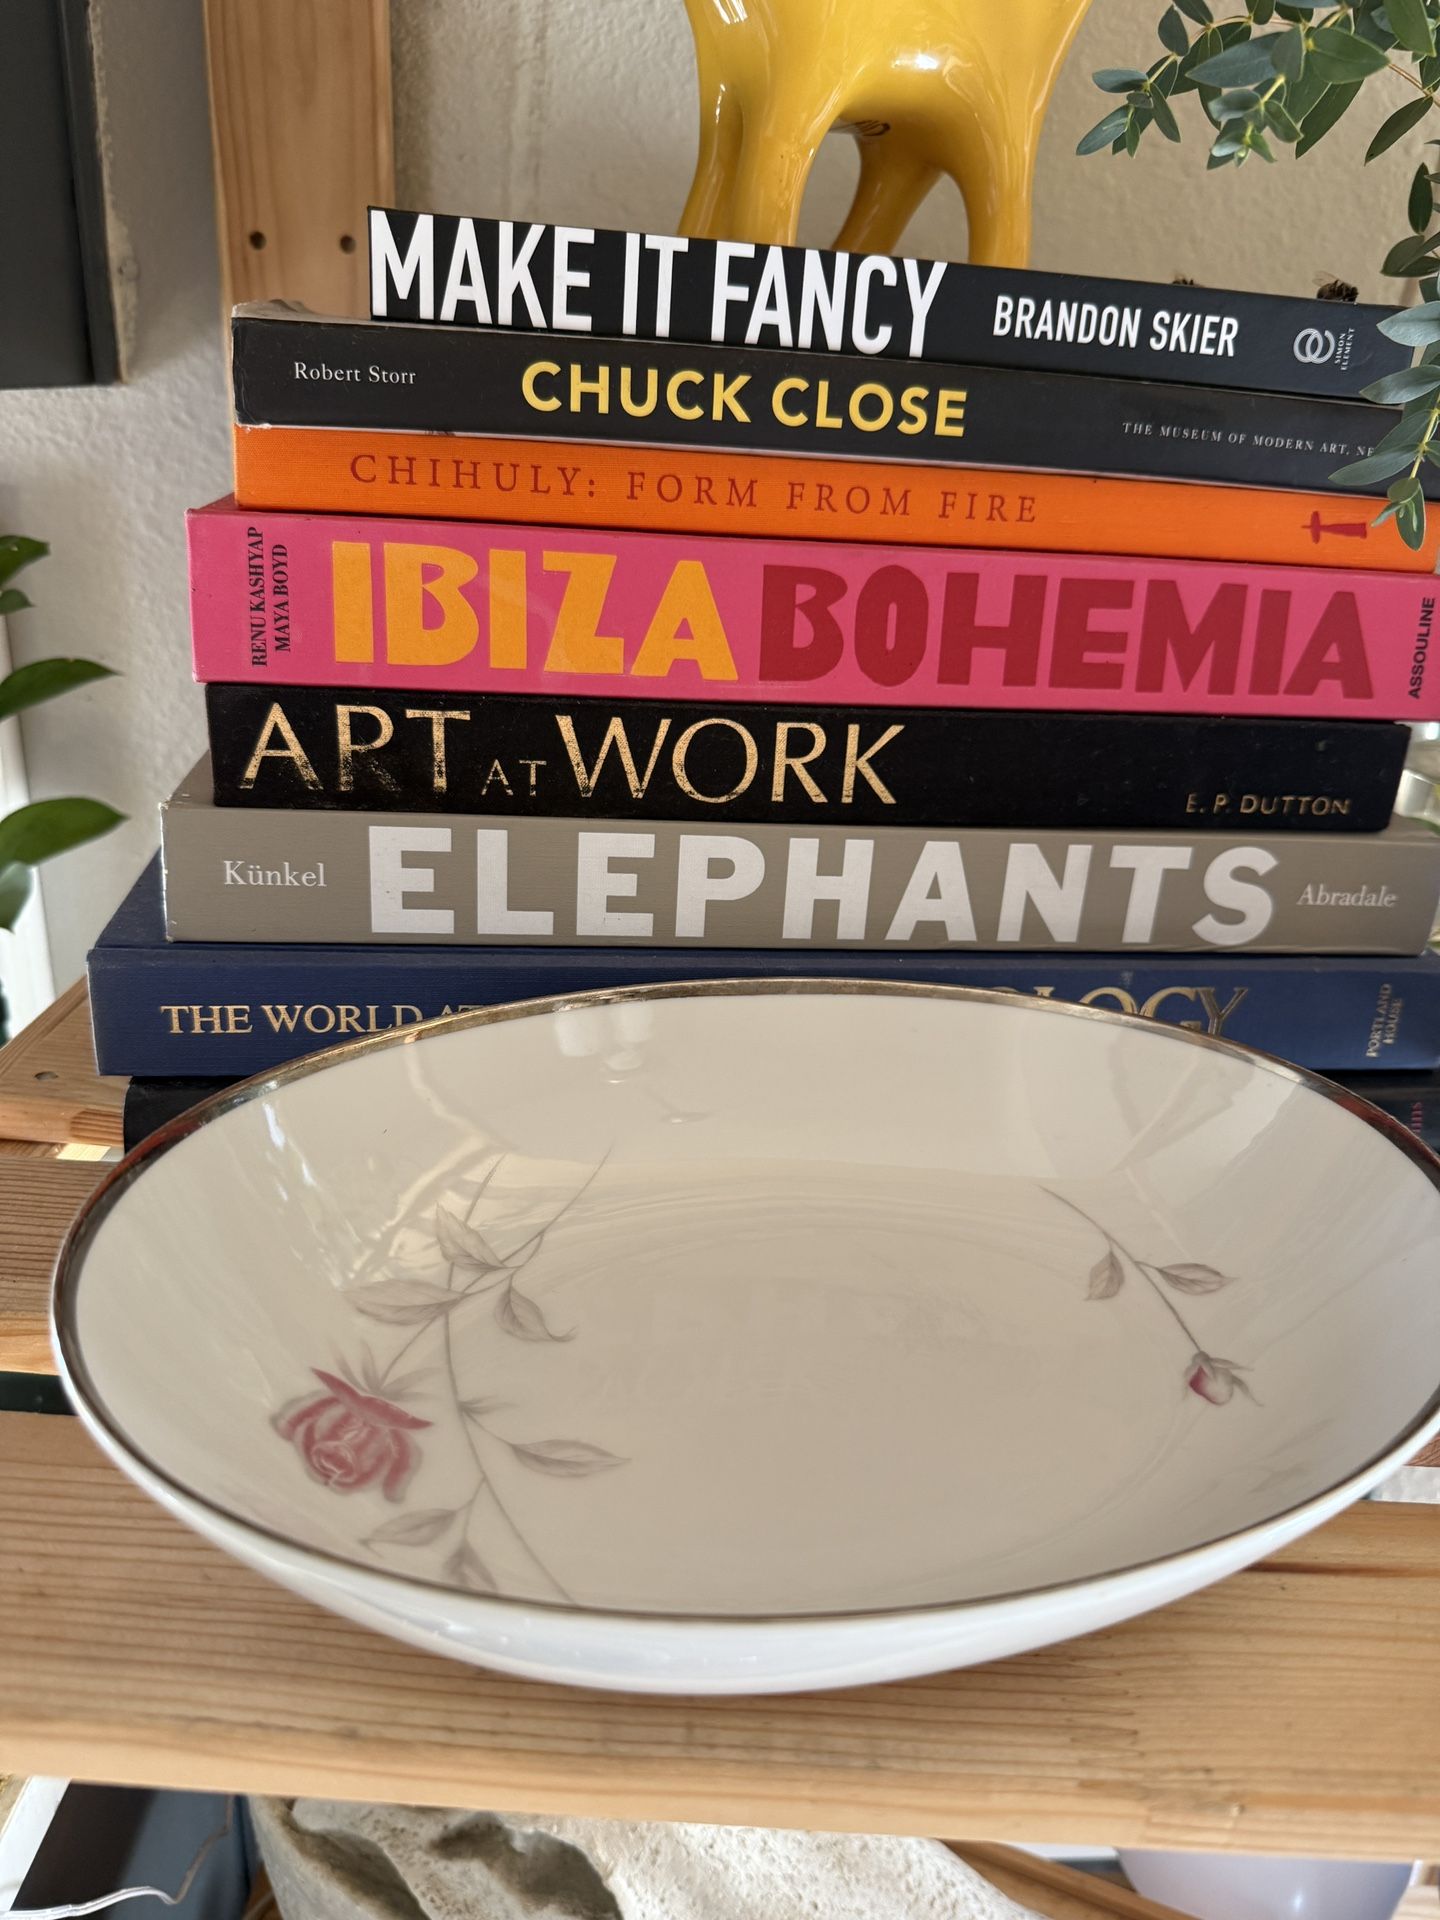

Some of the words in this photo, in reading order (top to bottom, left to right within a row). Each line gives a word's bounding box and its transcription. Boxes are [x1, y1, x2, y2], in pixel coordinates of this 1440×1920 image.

[370, 209, 596, 333] MAKE
[622, 231, 689, 339] IT
[710, 240, 949, 359] FANCY
[992, 295, 1143, 350] BRANDON
[1149, 312, 1240, 358] SKIER
[1334, 332, 1346, 364] SIMON
[1340, 327, 1356, 371] ELEMENT
[293, 361, 362, 383] Robert
[368, 364, 417, 385] Storr
[521, 361, 752, 424] CHUCK
[771, 376, 968, 438] CLOSE
[1122, 421, 1154, 437] THE
[1159, 424, 1222, 443] MUSEUM
[1228, 432, 1247, 445] OF
[1252, 434, 1315, 452] MODERN
[349, 454, 597, 499] CHIHULY:
[626, 471, 759, 509] FORM
[786, 481, 912, 517] FROM
[938, 490, 1037, 524] FIRE
[247, 526, 267, 615] KASHYAP
[271, 543, 290, 597] BOYD
[250, 615, 268, 668] RENU
[272, 600, 291, 653] MAYA
[331, 540, 739, 682] IBIZA
[758, 563, 1374, 700] BOHEMIA
[1408, 596, 1436, 700] ASSOULINE
[238, 701, 472, 796] ART
[480, 757, 548, 797] AT
[555, 713, 906, 806] WORK
[1185, 792, 1205, 815] E.
[1213, 793, 1232, 815] P.
[1239, 794, 1352, 816] DUTTON
[223, 860, 328, 888] Künkel
[367, 825, 1280, 947] ELEPHANTS
[1296, 884, 1398, 909] Abradale
[160, 1004, 254, 1035] THE
[260, 1004, 424, 1035] WORLD
[1365, 983, 1392, 1058] PORTLAND
[1382, 998, 1403, 1045] HOUSE
